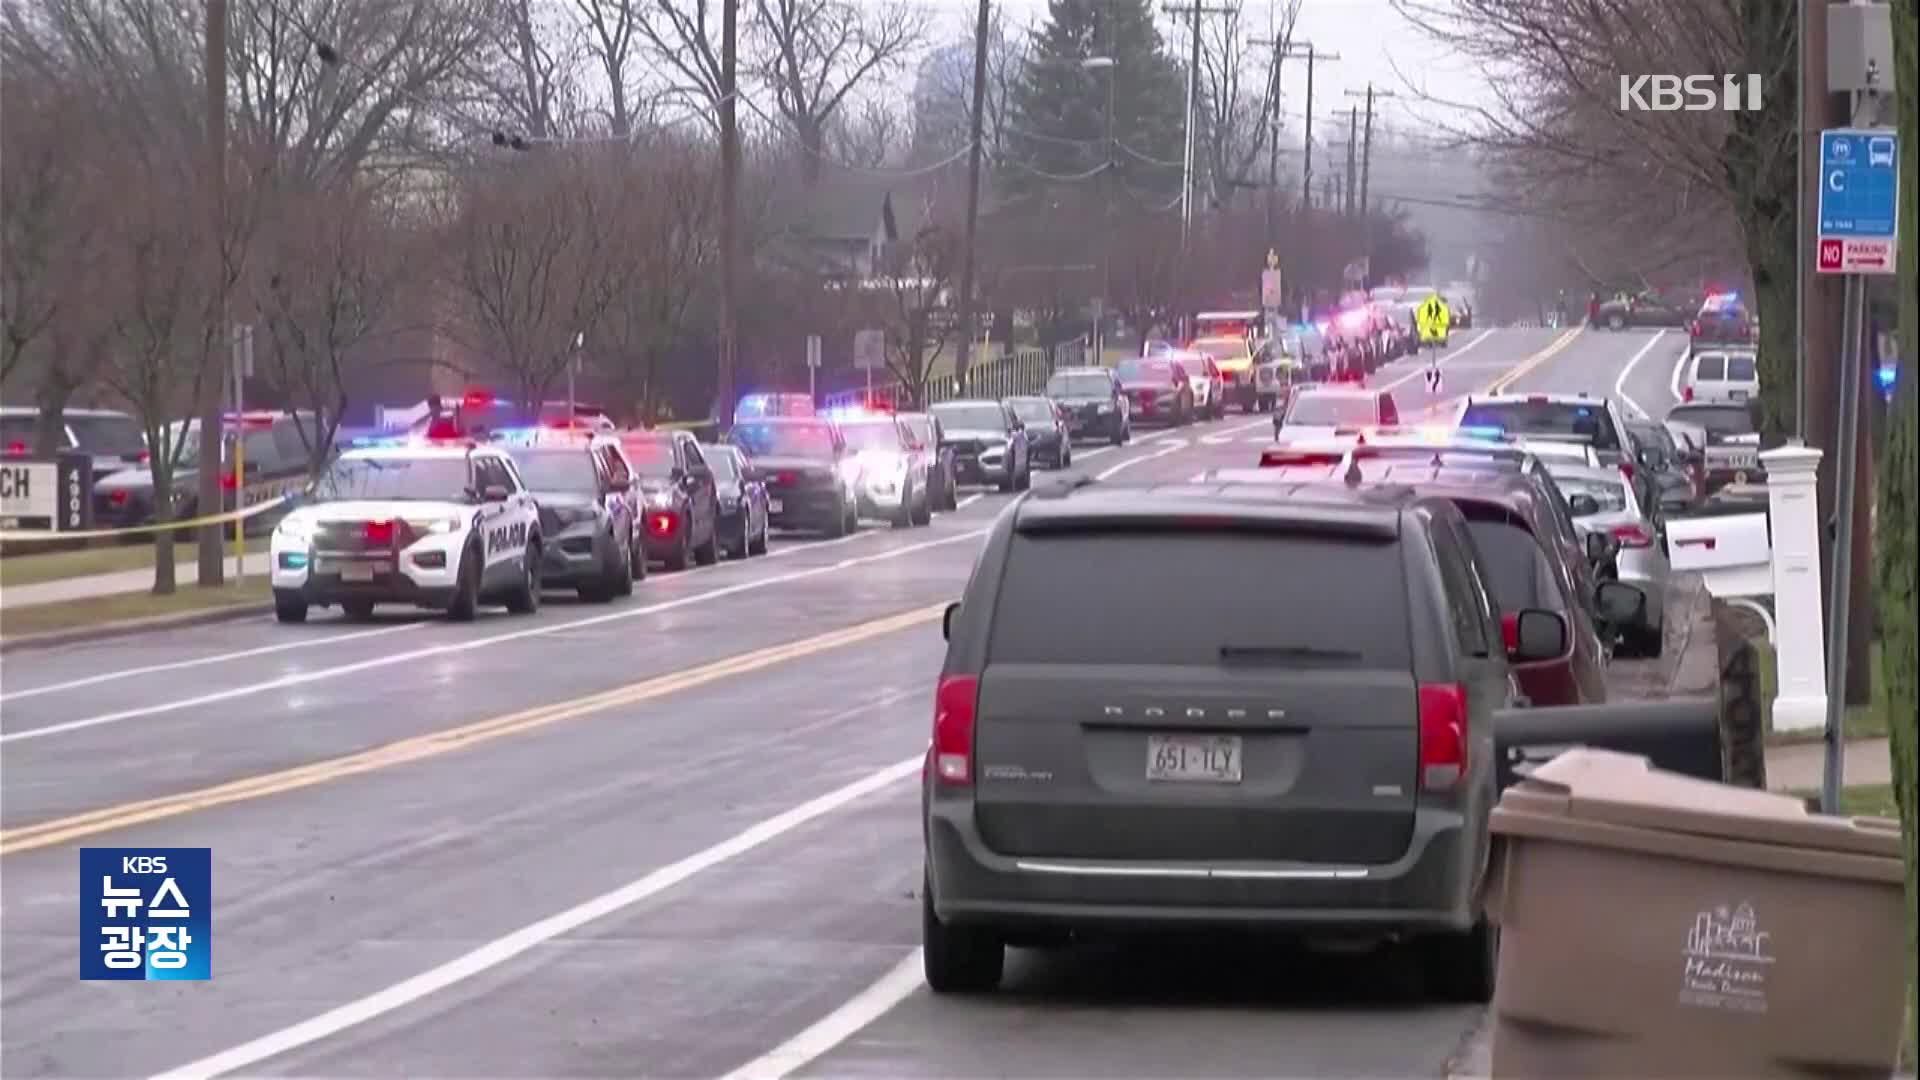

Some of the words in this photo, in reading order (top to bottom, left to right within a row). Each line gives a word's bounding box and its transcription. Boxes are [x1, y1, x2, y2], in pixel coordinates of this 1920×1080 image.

[1829, 169, 1845, 192] C
[1822, 244, 1841, 263] NO
[1847, 243, 1887, 255] PARKING
[0, 467, 30, 498] CH
[1684, 957, 1765, 981] Madison
